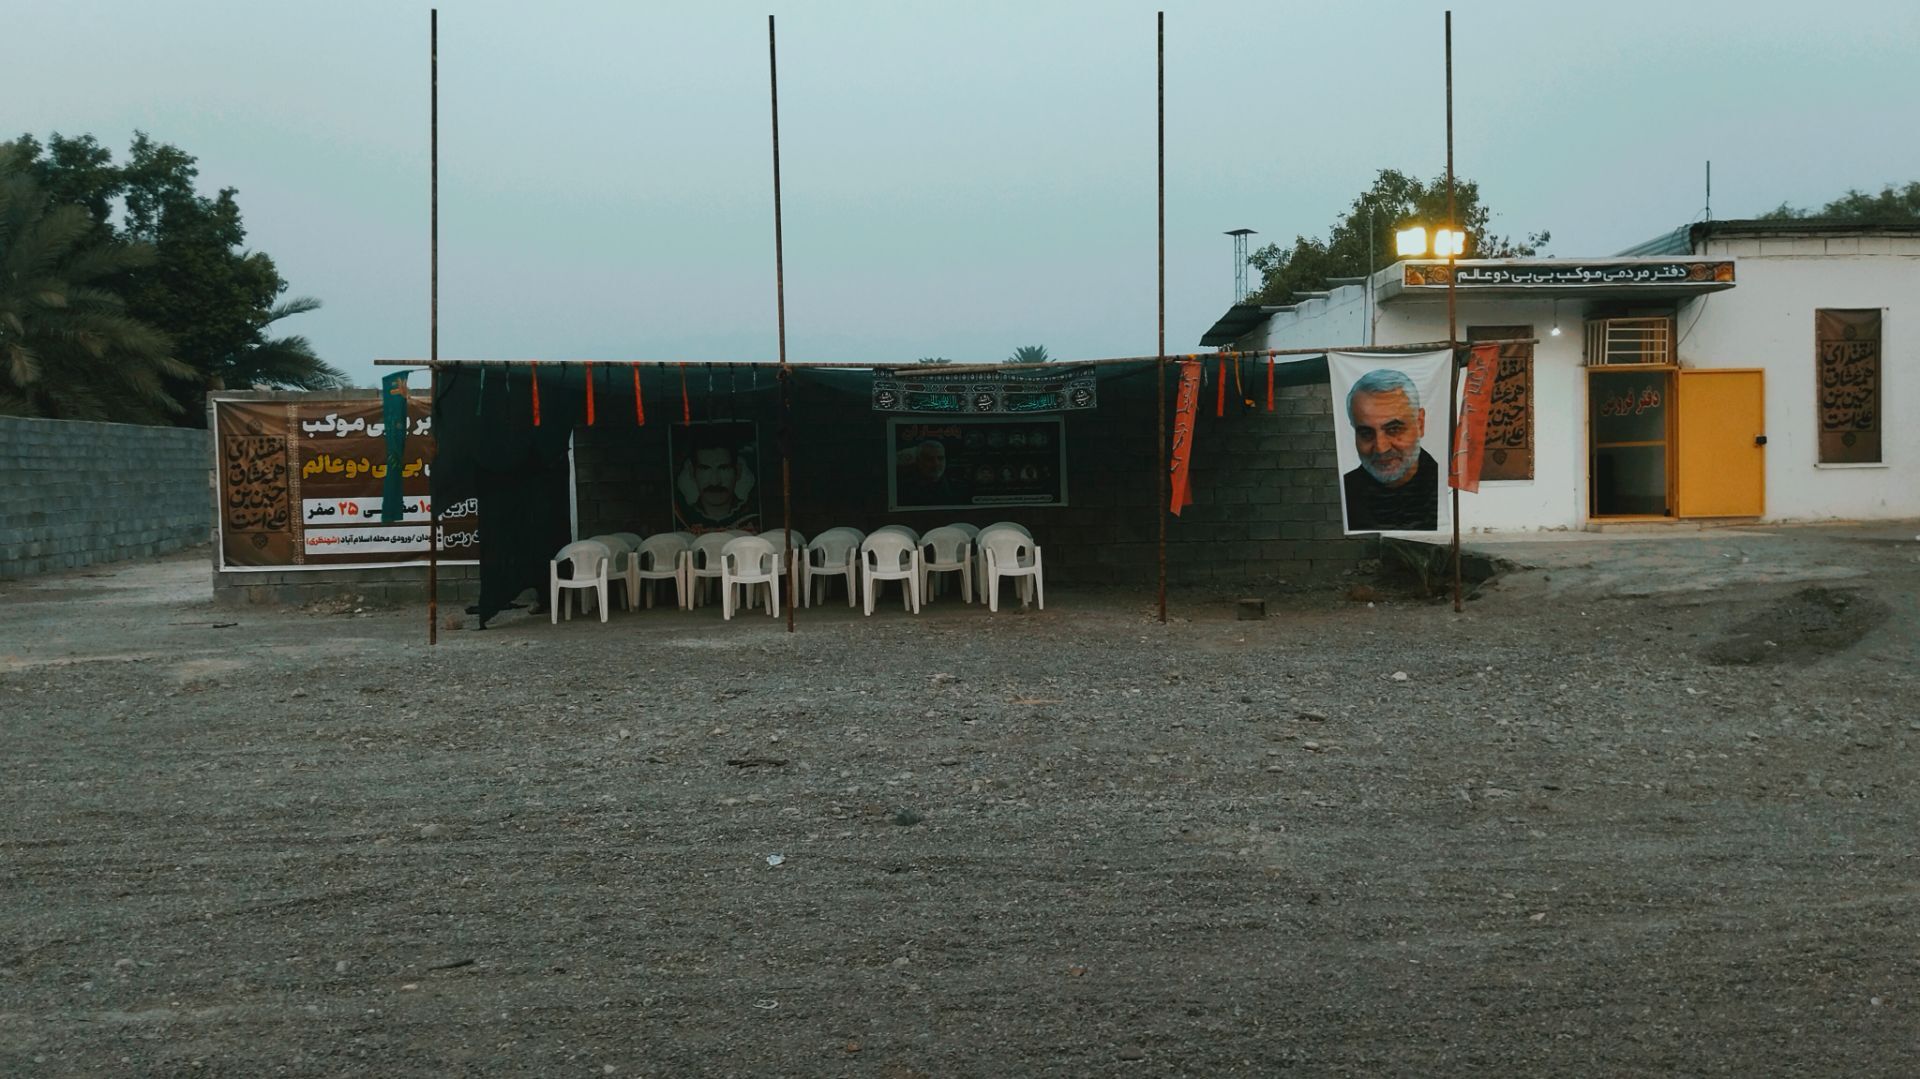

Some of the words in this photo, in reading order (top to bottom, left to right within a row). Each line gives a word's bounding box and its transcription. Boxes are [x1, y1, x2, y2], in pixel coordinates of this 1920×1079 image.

[1556, 266, 1602, 283] موکب
[1602, 269, 1650, 282] مردمی
[1650, 265, 1687, 281] دفتر
[1635, 385, 1661, 415] دفتر
[302, 413, 365, 438] موکب
[307, 502, 335, 519] صفر
[338, 502, 359, 516] ۲۵
